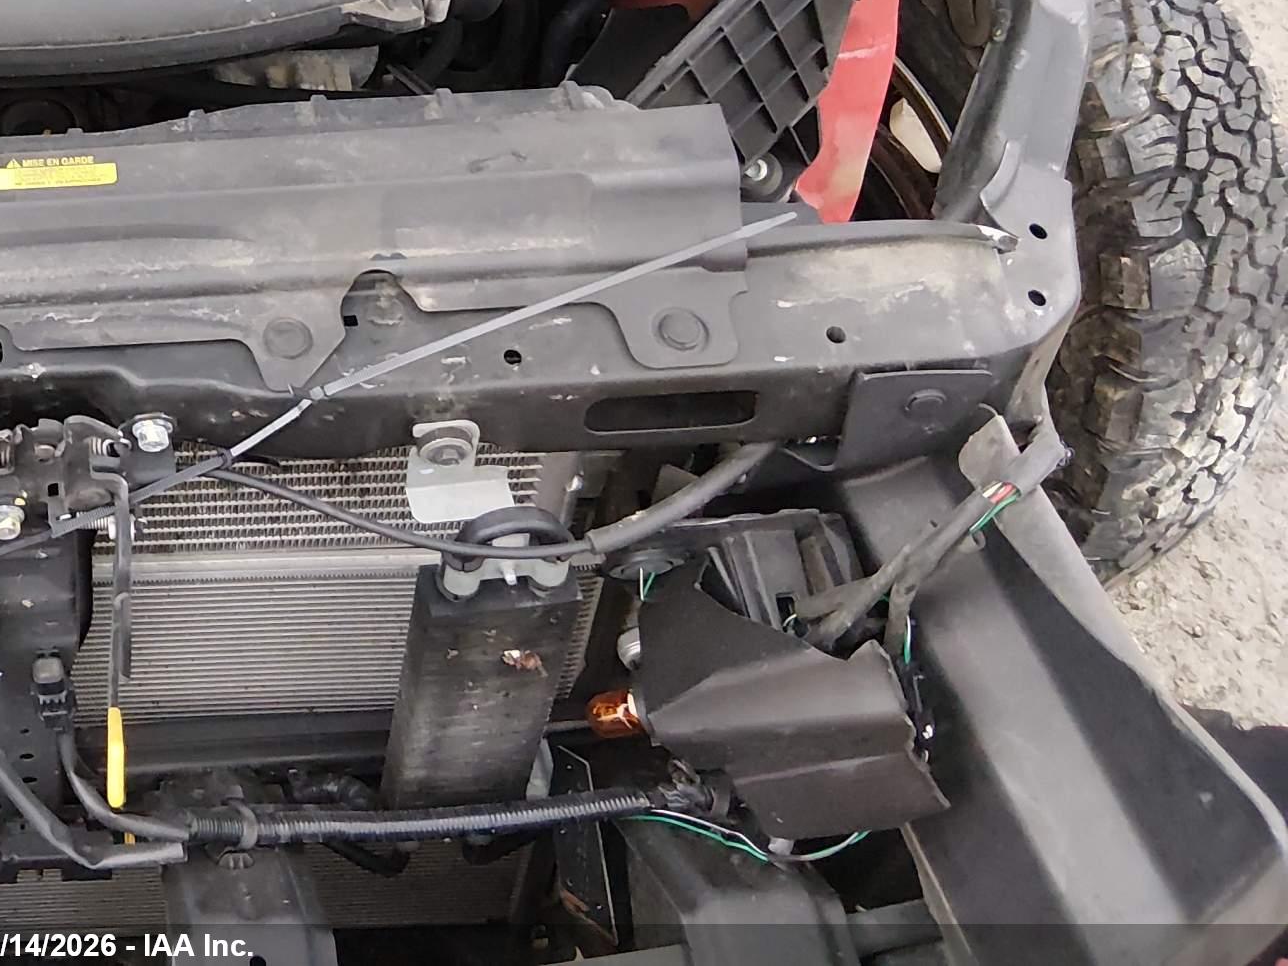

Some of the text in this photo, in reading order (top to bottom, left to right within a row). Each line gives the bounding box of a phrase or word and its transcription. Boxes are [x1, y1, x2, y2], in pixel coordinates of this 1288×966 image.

[22, 155, 94, 168] MISE EN GARDE
